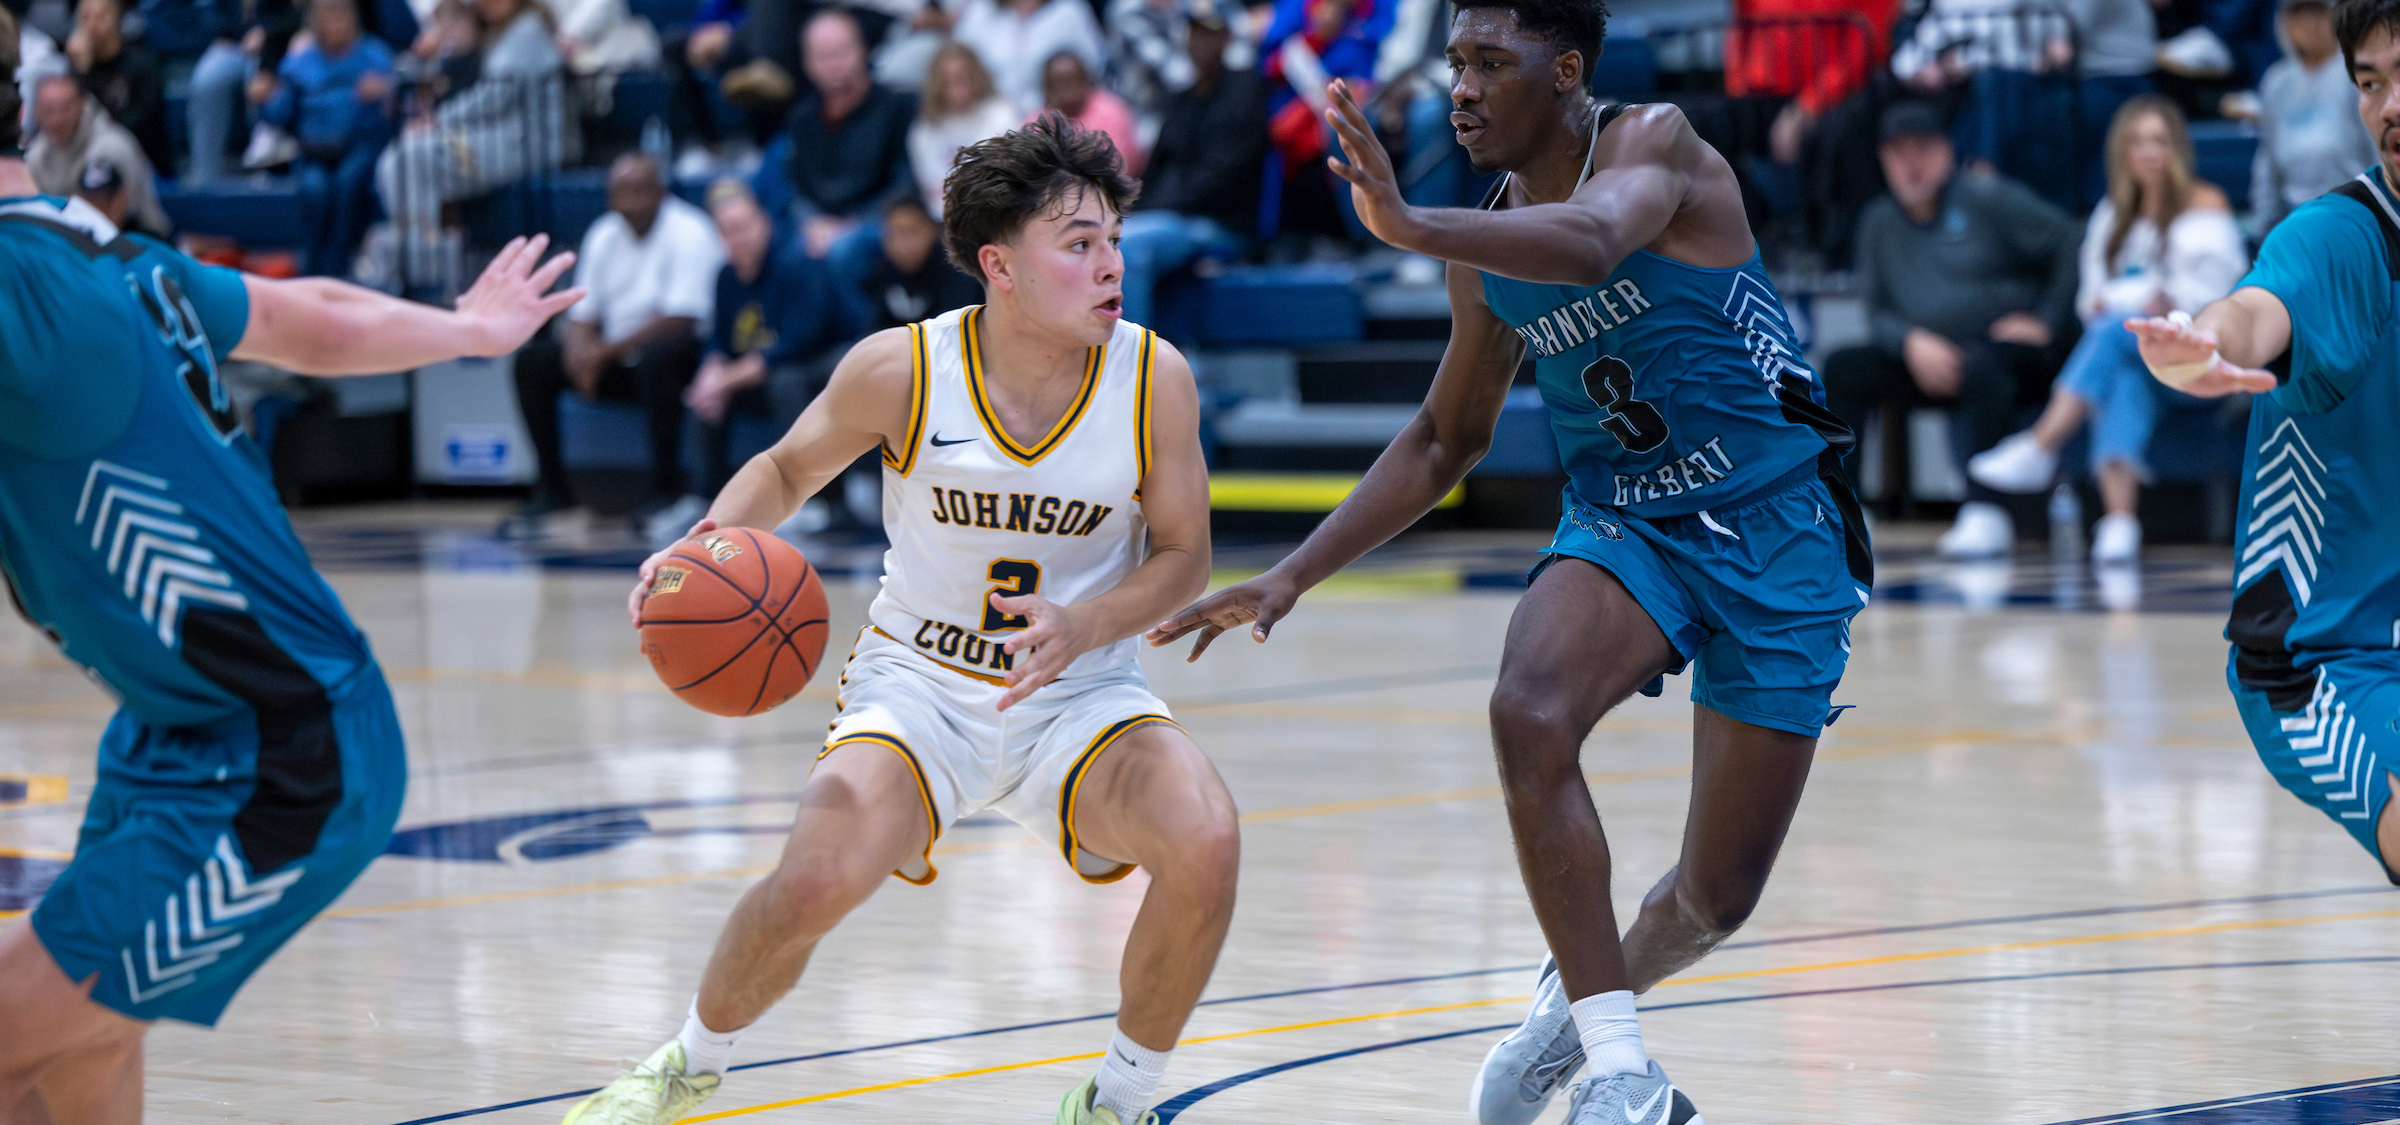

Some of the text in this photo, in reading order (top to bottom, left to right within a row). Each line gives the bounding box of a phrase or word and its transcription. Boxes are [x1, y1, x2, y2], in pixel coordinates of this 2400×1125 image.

[1581, 354, 1670, 455] 3
[1612, 435, 1735, 507] GILBERT
[931, 486, 1114, 537] JOHNSON
[979, 556, 1042, 634] 2
[914, 619, 1037, 671] COUN
